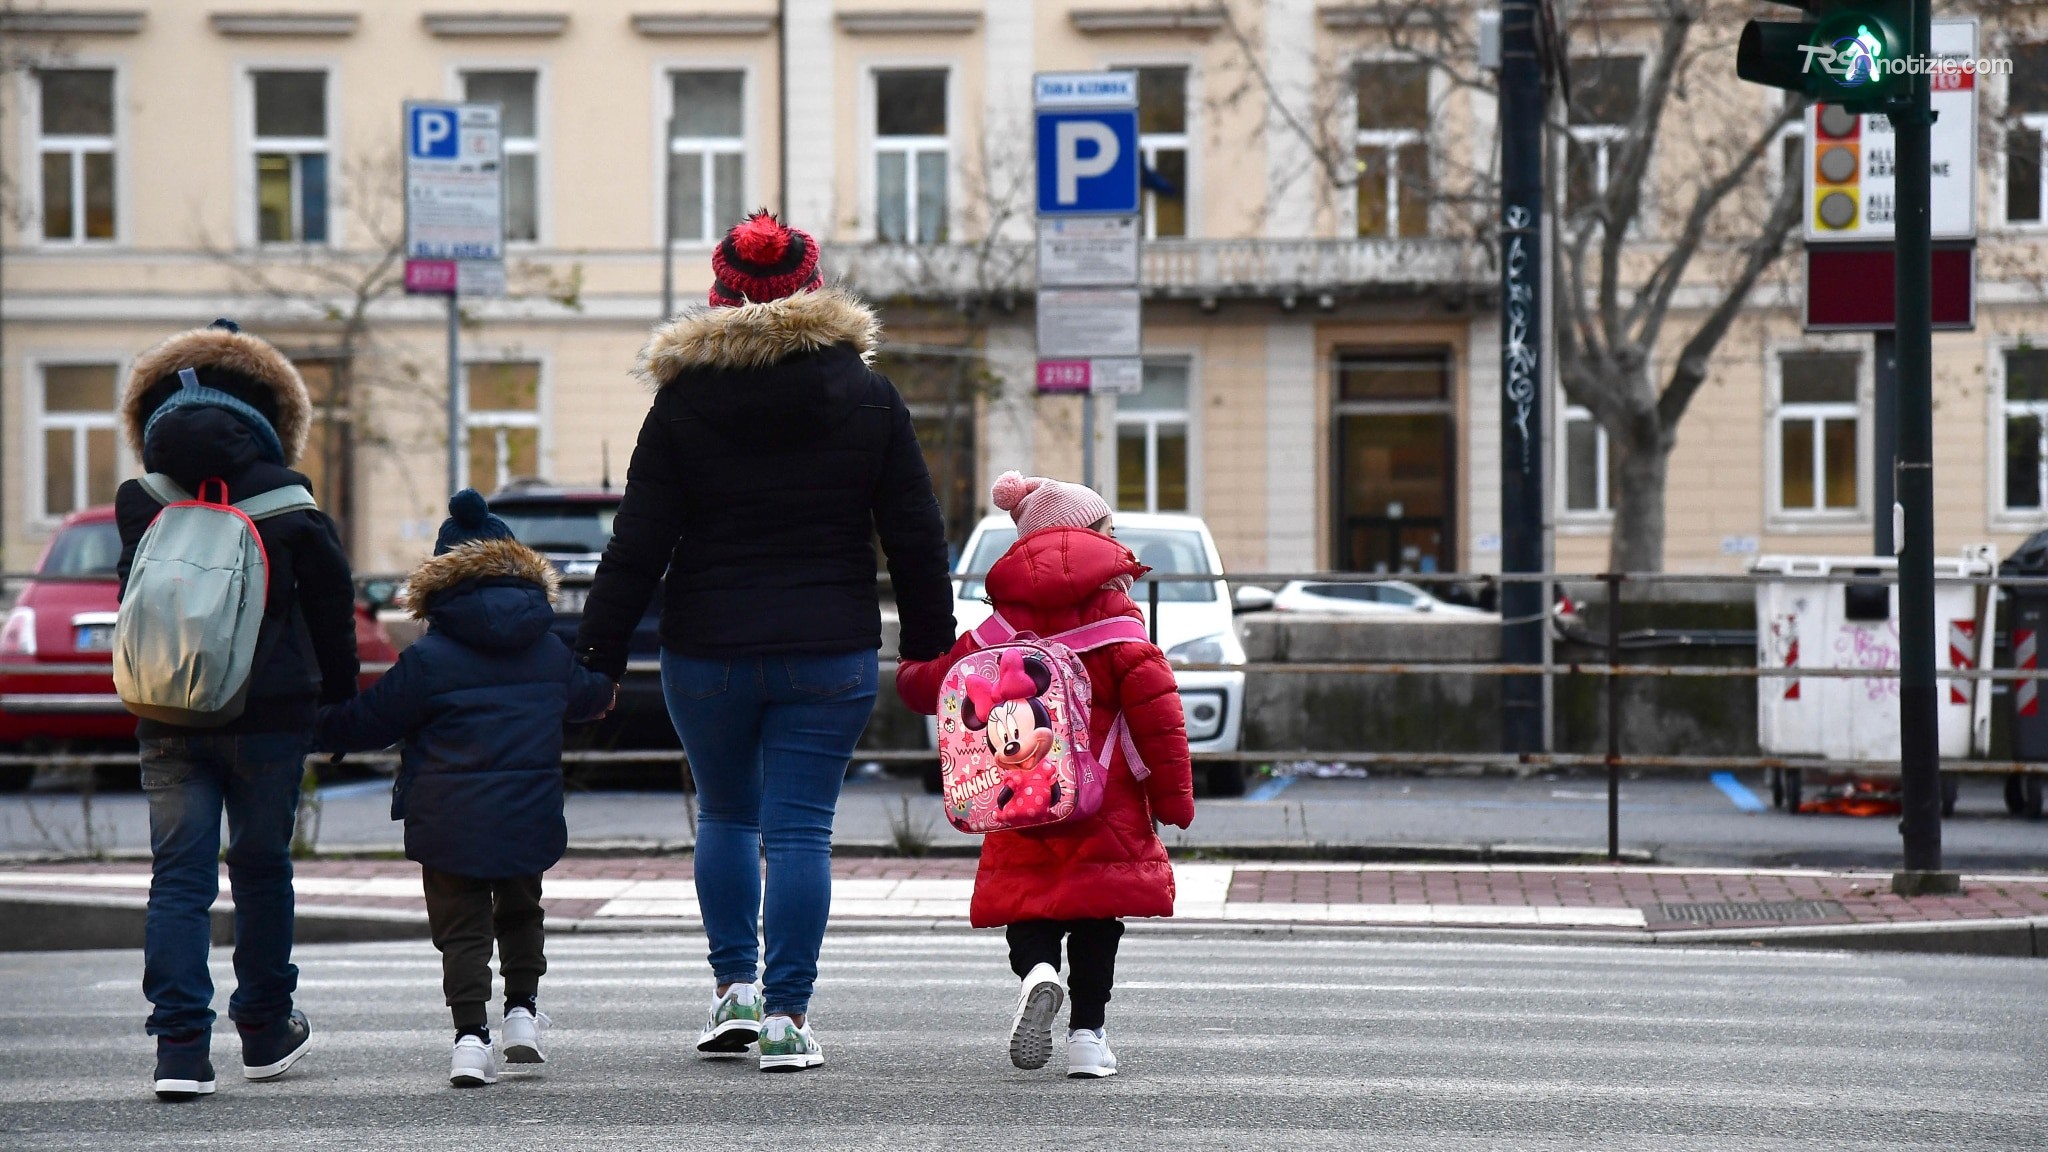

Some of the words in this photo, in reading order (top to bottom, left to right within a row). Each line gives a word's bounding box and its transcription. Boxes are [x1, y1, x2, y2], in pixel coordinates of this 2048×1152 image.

[418, 112, 450, 155] P
[1056, 120, 1121, 205] P
[950, 765, 1002, 806] MINNIE
